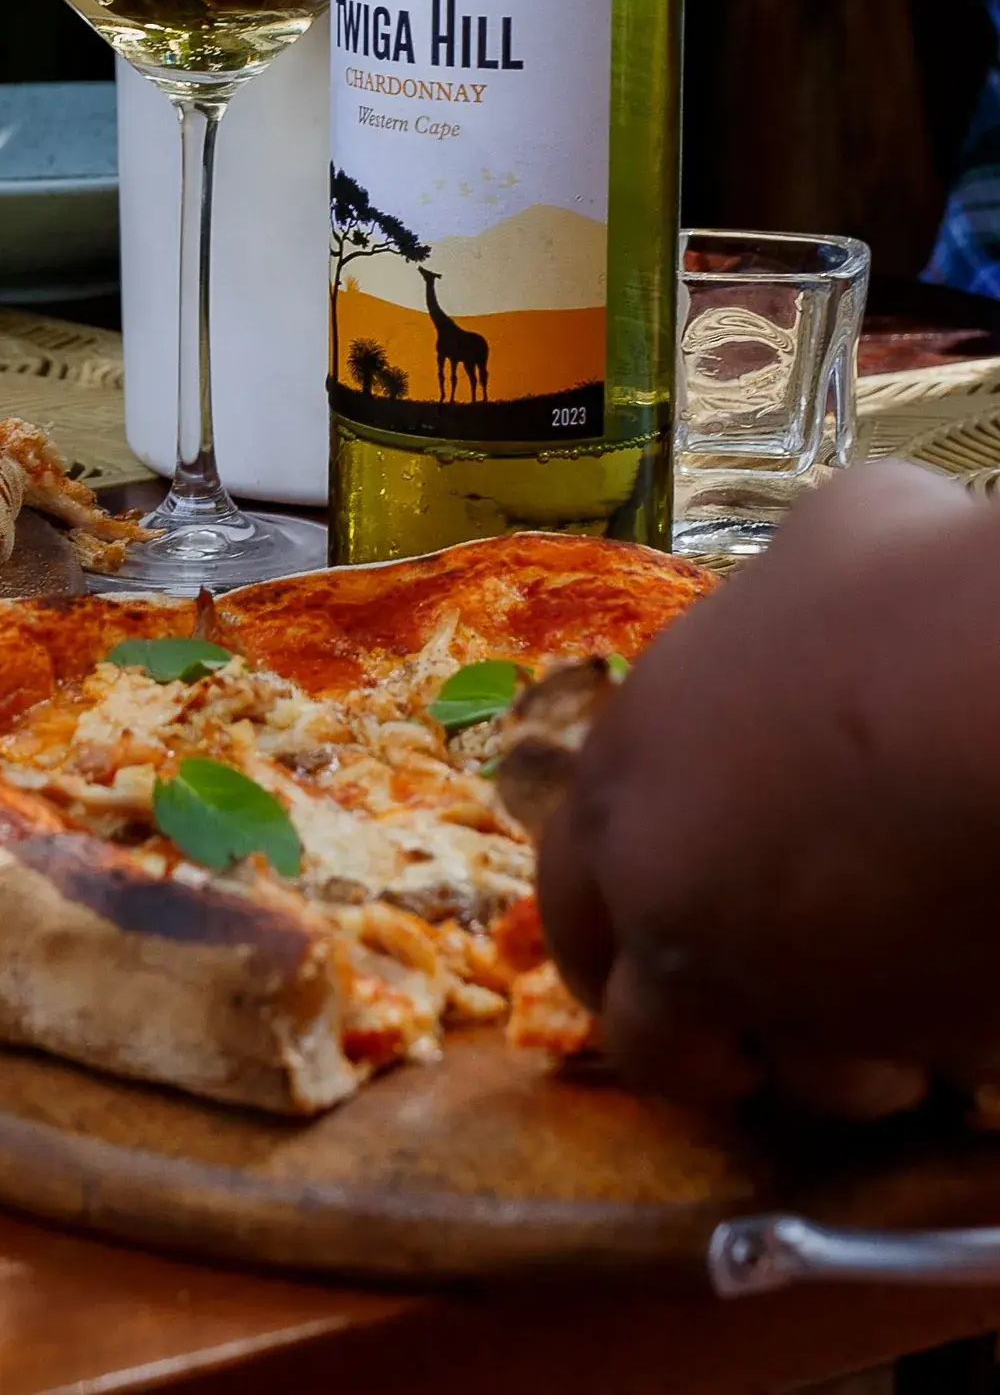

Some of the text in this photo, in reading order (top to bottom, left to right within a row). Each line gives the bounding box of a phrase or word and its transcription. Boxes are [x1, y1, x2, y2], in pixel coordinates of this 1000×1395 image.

[345, 66, 488, 104] CHARDONNAY
[356, 105, 461, 141] Western Cape
[551, 406, 587, 427] 2023
